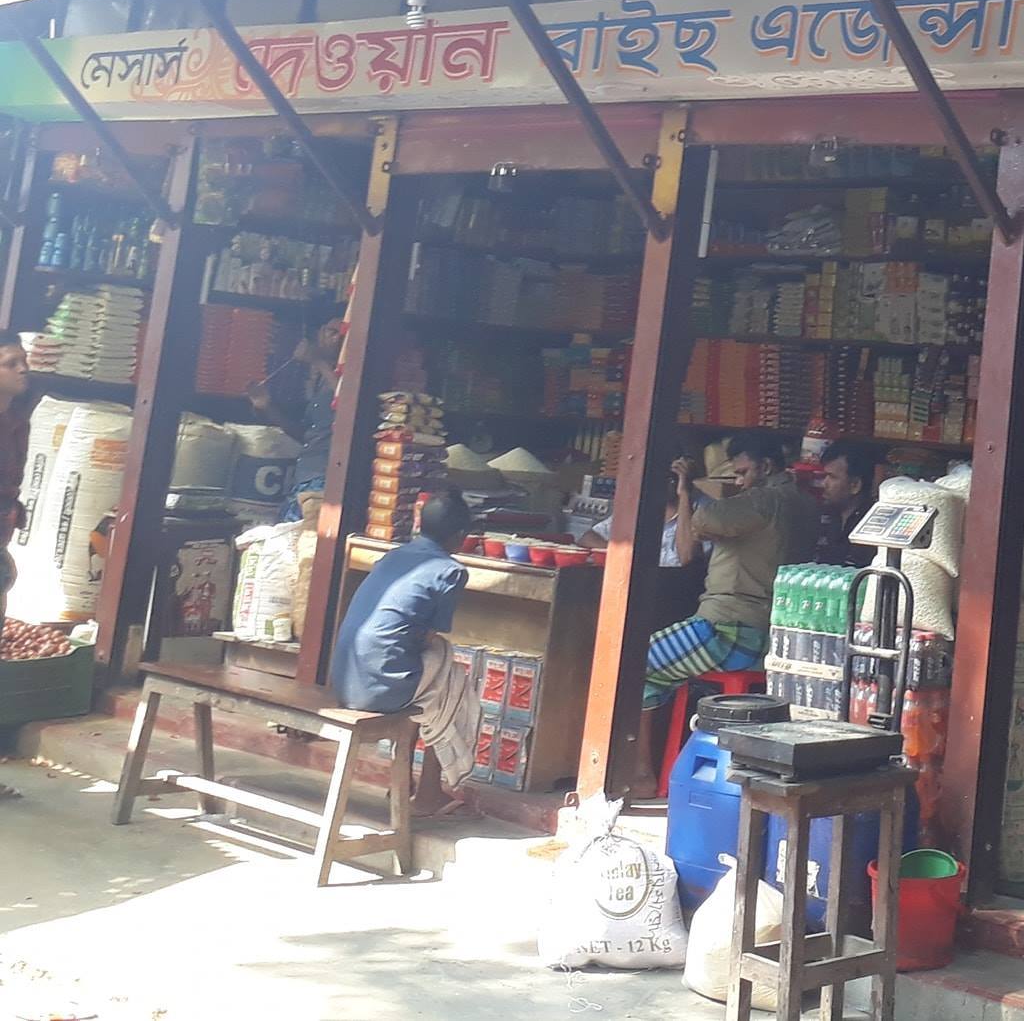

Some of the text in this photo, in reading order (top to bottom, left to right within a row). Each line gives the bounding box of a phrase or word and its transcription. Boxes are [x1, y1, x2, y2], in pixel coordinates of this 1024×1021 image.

[80, 37, 189, 89] মেসার্স
[234, 19, 509, 97] দেওয়ান
[628, 939, 645, 953] 12
